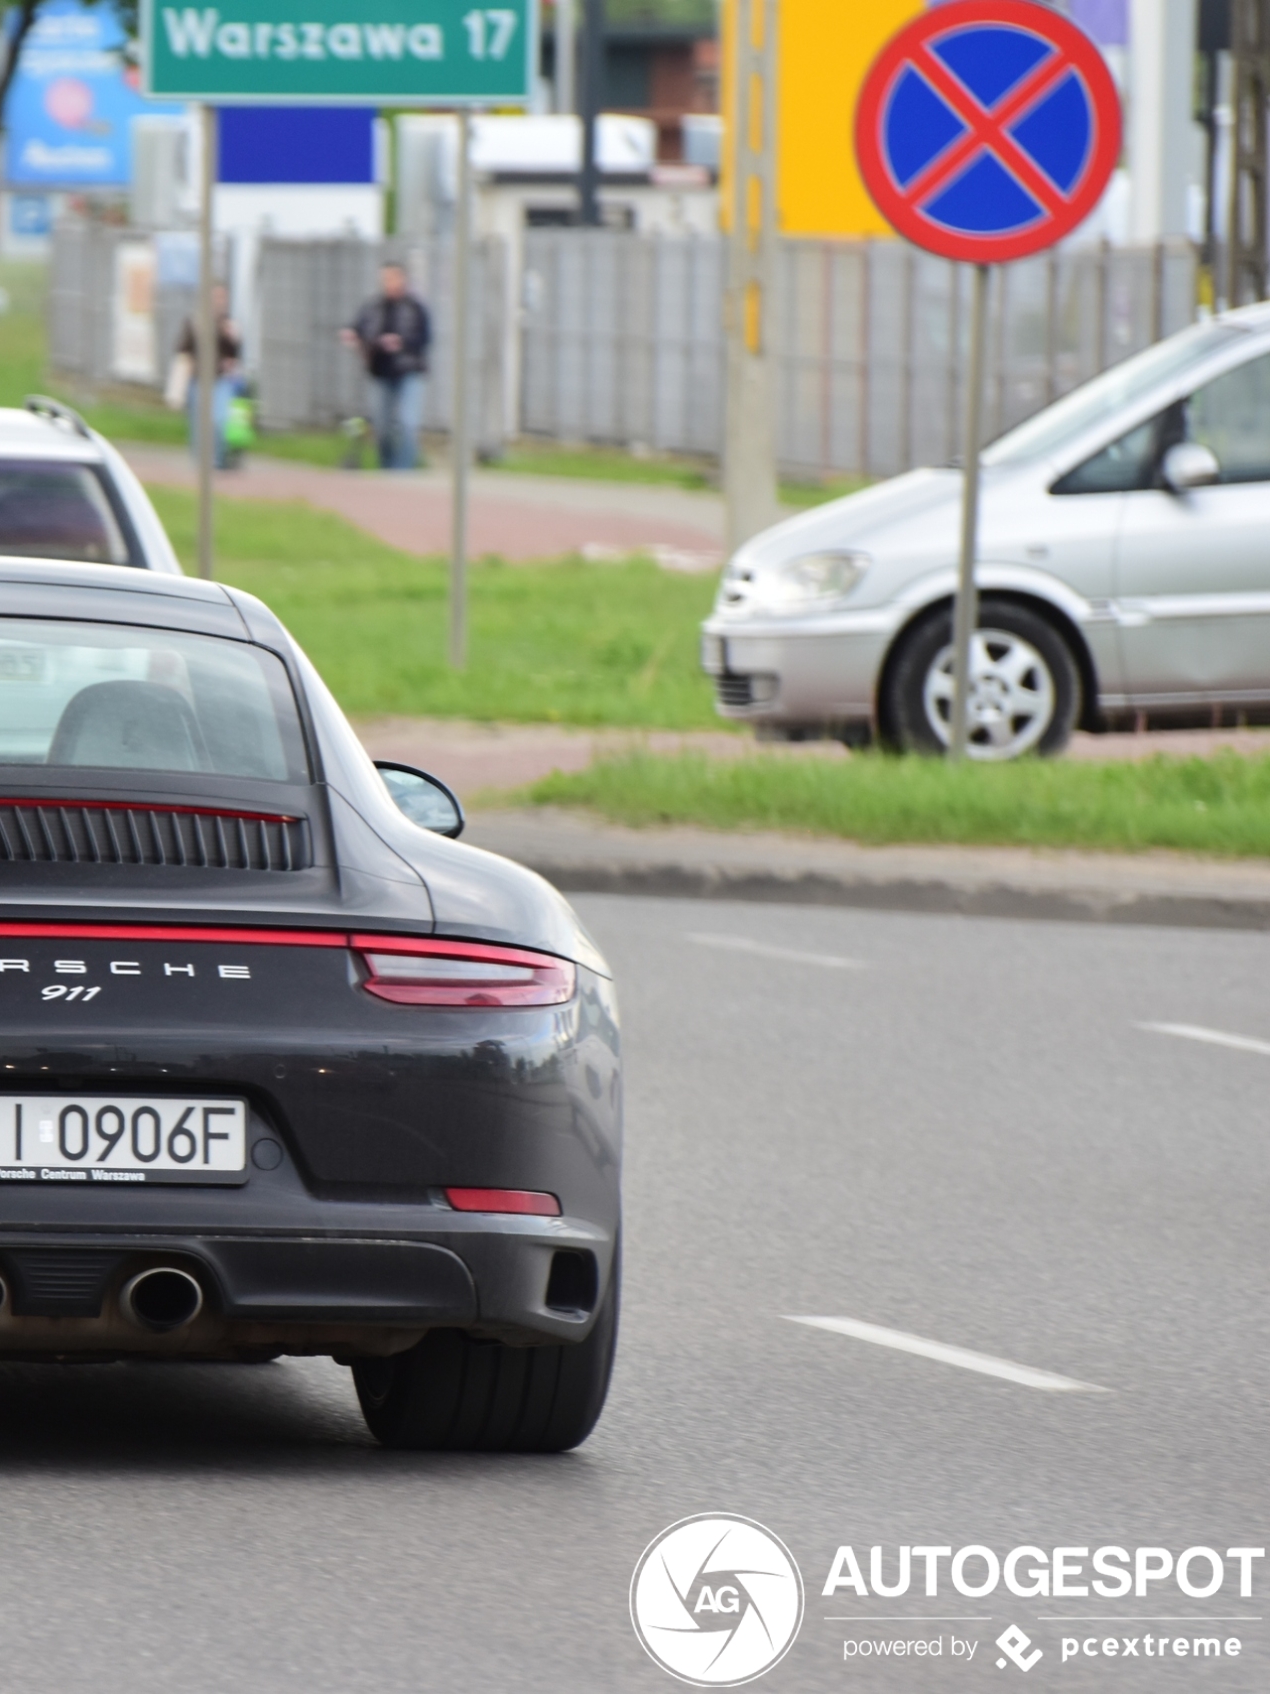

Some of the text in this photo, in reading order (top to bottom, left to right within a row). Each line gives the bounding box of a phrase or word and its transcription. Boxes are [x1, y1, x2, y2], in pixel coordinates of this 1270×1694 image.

[162, 6, 445, 60] Warszawa
[462, 9, 517, 61] 17
[41, 984, 102, 1001] 911
[58, 1104, 236, 1165] 0906F
[40, 1168, 87, 1181] Centrum
[91, 1169, 145, 1182] Warszawa
